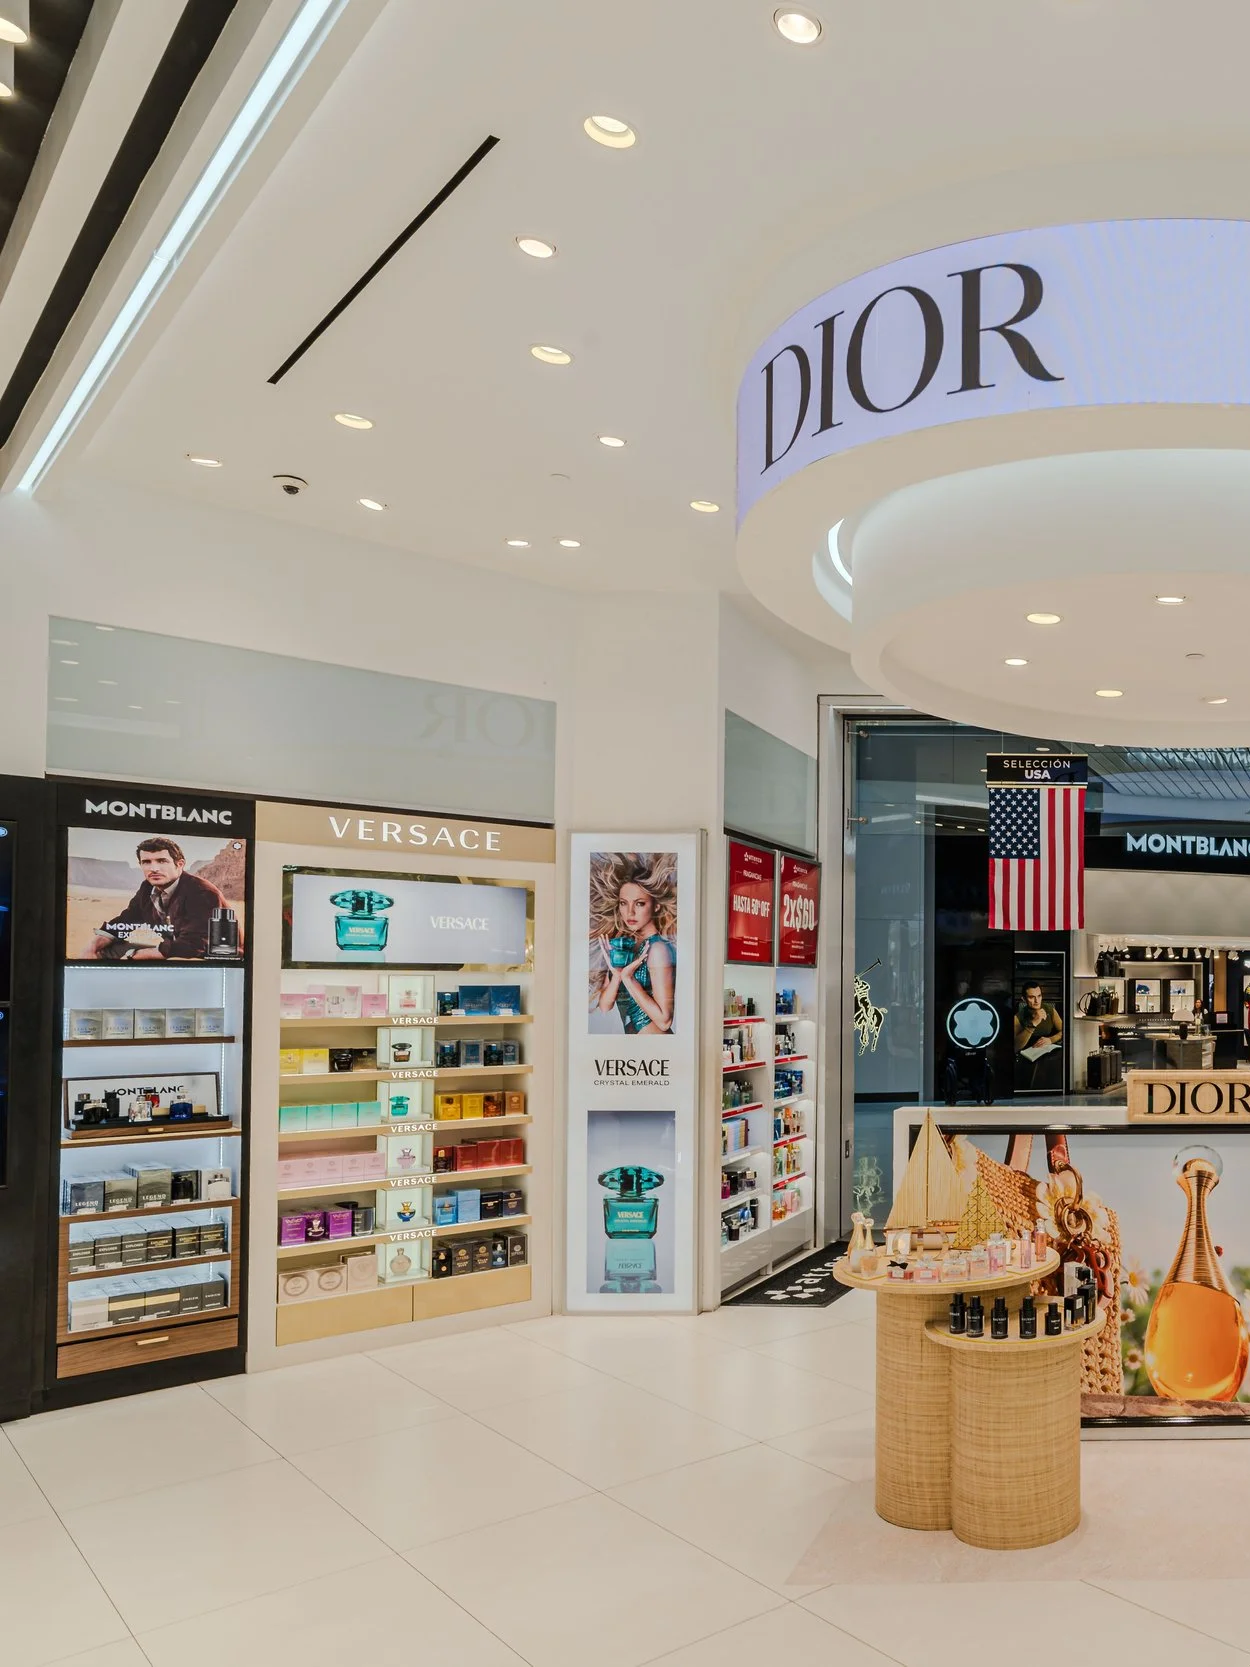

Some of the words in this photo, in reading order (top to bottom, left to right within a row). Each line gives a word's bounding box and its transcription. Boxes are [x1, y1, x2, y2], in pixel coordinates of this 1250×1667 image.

[761, 262, 1064, 475] DIOR
[1003, 759, 1071, 769] SELECCIÓN
[1024, 769, 1051, 780] USA
[84, 798, 233, 826] MONTBLANC
[328, 816, 502, 852] VERSACE
[733, 894, 751, 914] HASTA
[760, 900, 770, 918] OFF
[430, 915, 490, 931] VERSACE
[391, 1016, 439, 1025] VERSACE
[391, 1070, 439, 1079] VERSACE
[594, 1059, 670, 1077] VERSACE
[390, 1122, 438, 1133] VERSACE
[390, 1176, 438, 1187] VERSACE
[389, 1229, 438, 1242] VERSACE
